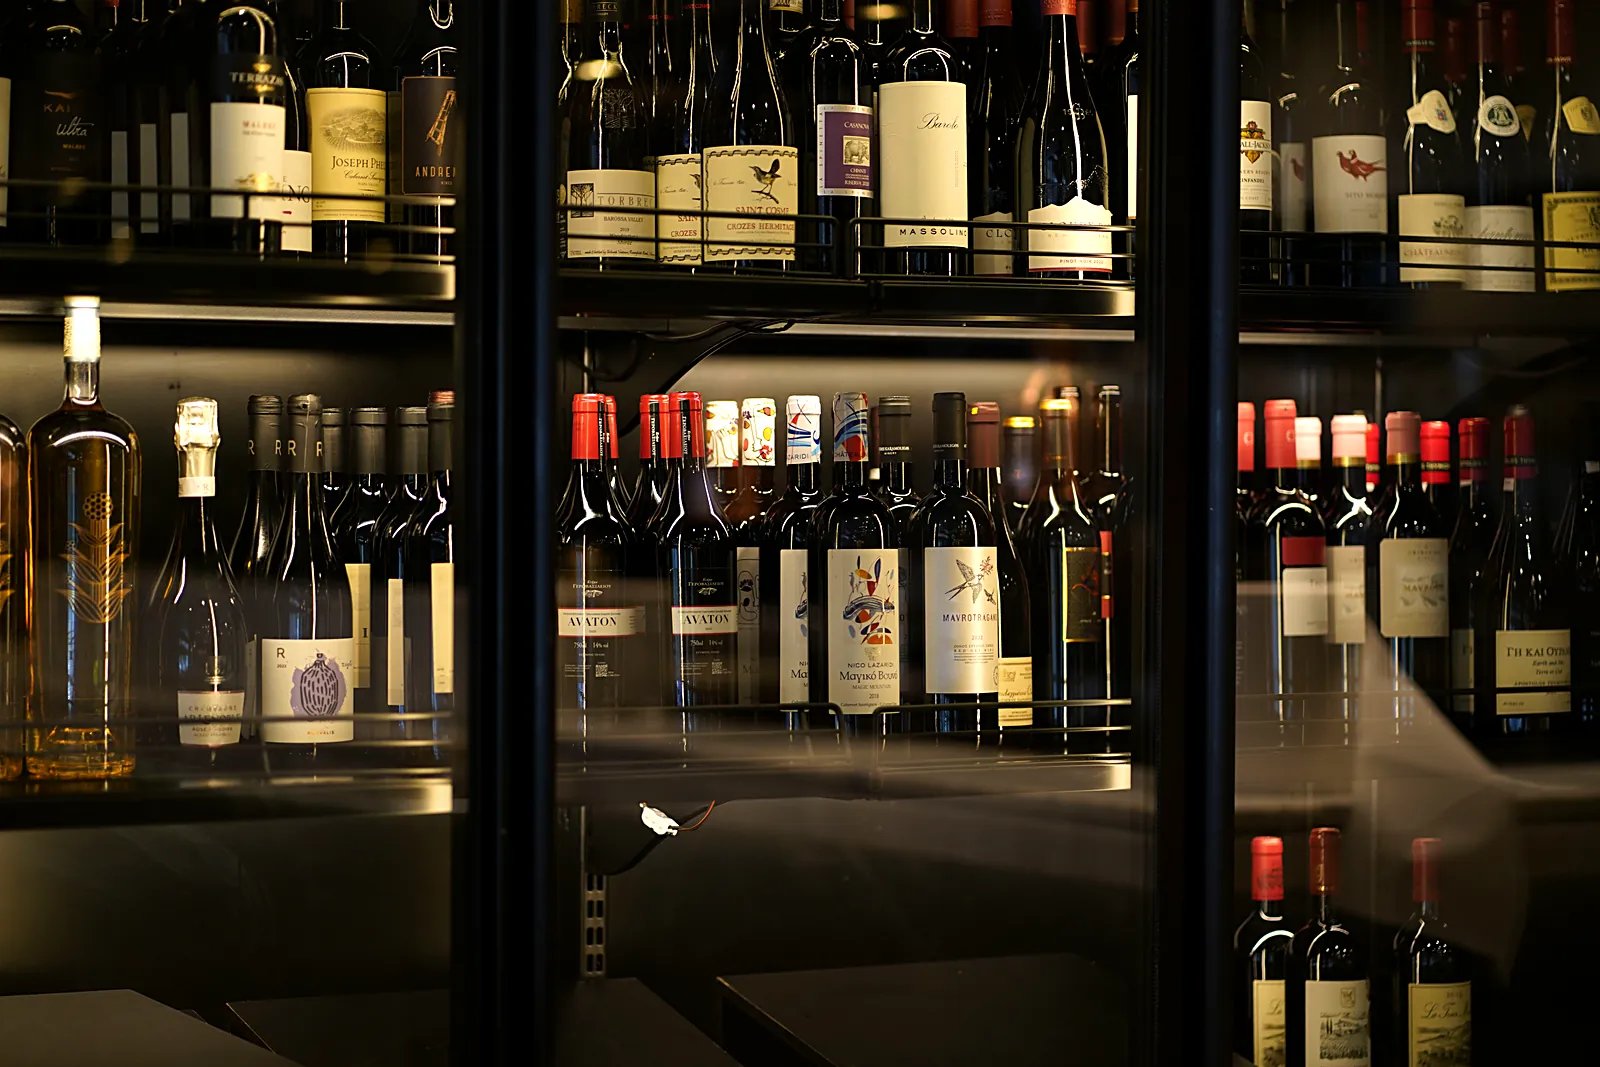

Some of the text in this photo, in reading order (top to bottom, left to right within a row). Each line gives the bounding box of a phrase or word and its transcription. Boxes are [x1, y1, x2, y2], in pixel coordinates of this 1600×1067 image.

[43, 103, 71, 113] KAI
[331, 156, 369, 170] JOSEPH
[726, 222, 756, 231] CROZES
[274, 439, 282, 456] R
[286, 439, 324, 457] R R
[567, 616, 618, 627] AVATON
[682, 614, 730, 625] AVATON
[276, 647, 285, 659] R
[1506, 647, 1522, 657] ΓΗ
[1525, 647, 1545, 657] ΚΑΙ
[839, 670, 877, 684] Μαγικό
